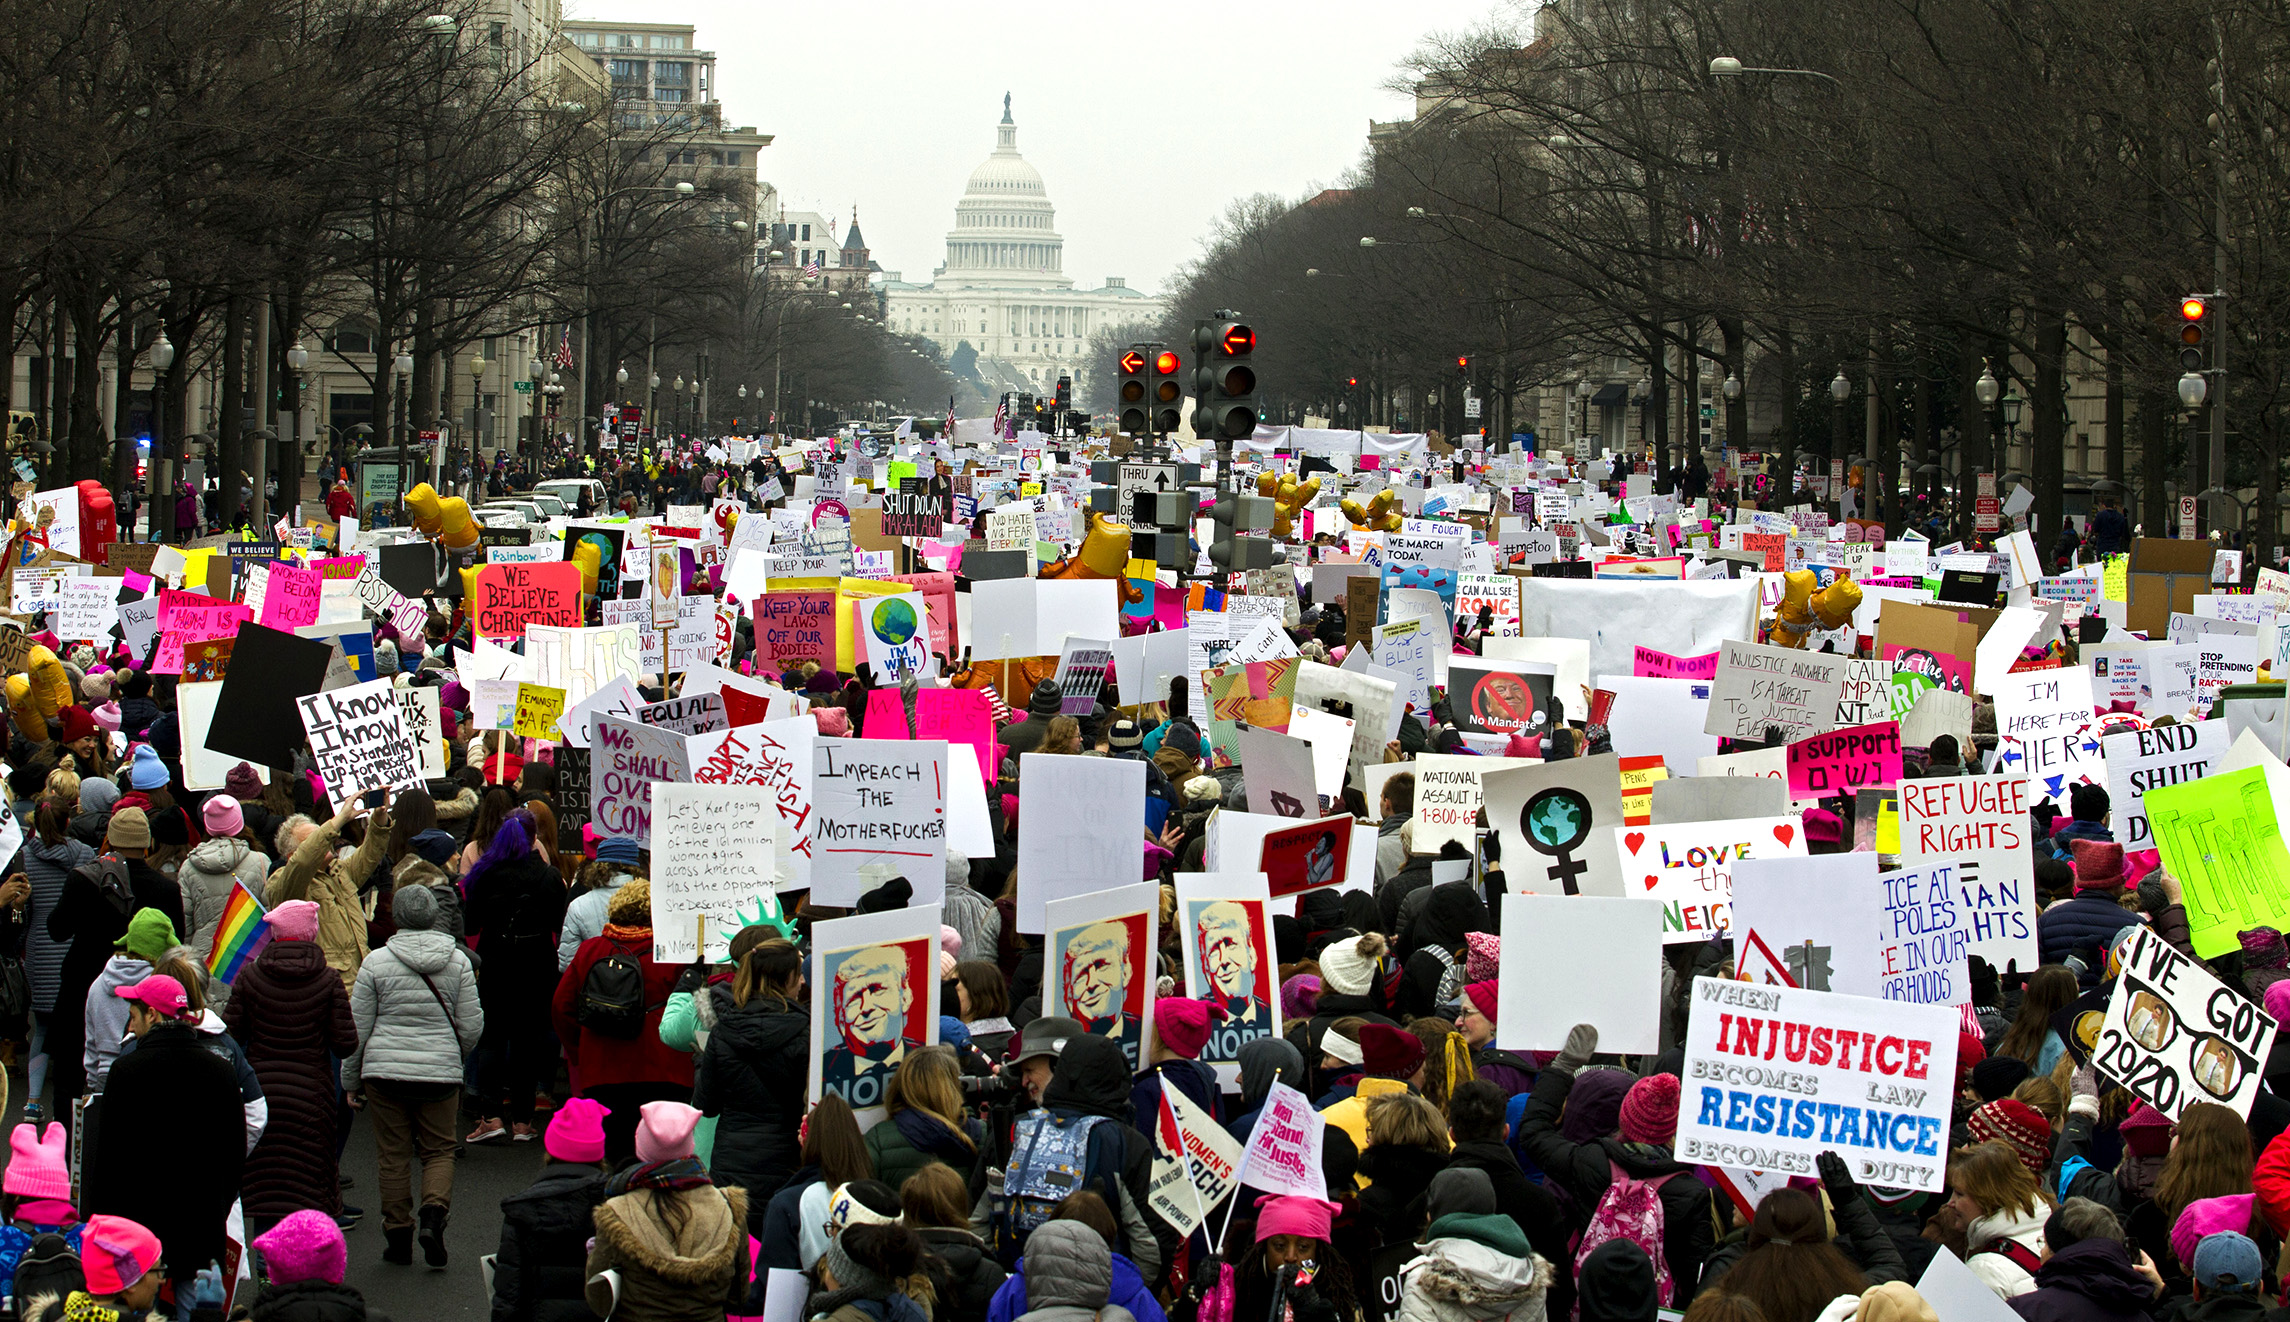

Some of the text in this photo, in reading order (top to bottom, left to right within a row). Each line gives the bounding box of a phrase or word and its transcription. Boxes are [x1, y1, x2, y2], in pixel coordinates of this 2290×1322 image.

[819, 463, 838, 473] THIS
[1123, 468, 1149, 480] THRU
[818, 472, 839, 480] AIN'T
[883, 494, 942, 516] SHUT DOWN
[993, 514, 1031, 525] NO HATE
[1121, 518, 1154, 530] SIGNAL
[991, 527, 1032, 538] NO FEAR
[1408, 522, 1464, 535] WE FOUGHT
[482, 536, 522, 546] THE POWER
[991, 538, 1030, 549] EVERYONE
[1388, 538, 1443, 550] WE MARCH
[1744, 534, 1756, 542] THIS
[1503, 540, 1551, 555] #metoo
[1754, 543, 1786, 551] MOMENT
[1845, 545, 1870, 554] SPEAK
[492, 551, 537, 562] Rainbow
[1388, 551, 1423, 561] TODAY.
[1768, 555, 1782, 564] THE
[1852, 555, 1863, 563] UP
[773, 557, 828, 571] KEEP YOUR
[272, 564, 315, 583] WOMEN
[503, 566, 530, 587] WE
[1463, 586, 1512, 596] CAN ALL SEE
[1876, 580, 1892, 588] YOU
[78, 592, 91, 601] only
[93, 592, 108, 601] thing
[1254, 596, 1278, 606] YOUR
[81, 601, 99, 609] afraid
[605, 601, 641, 612] UNLESS
[657, 603, 676, 612] IMPEACH
[763, 597, 830, 619] KEEP YOUR
[125, 609, 154, 626] REAL
[217, 611, 232, 629] IS
[605, 613, 620, 624] YOU
[783, 616, 818, 628] LAWS
[679, 632, 707, 644] GOING
[767, 629, 824, 645] OFF OUR
[768, 644, 822, 660] BODIES.
[890, 645, 909, 657] I'M
[1385, 647, 1423, 667] BLUE
[2200, 653, 2224, 661] STOP
[1636, 649, 1717, 672] NOW I WON'T
[1729, 648, 1788, 674] INJUSTICE
[2200, 661, 2254, 672] PRETENDING
[2199, 670, 2222, 679] YOUR
[519, 688, 558, 708] FEMINIST
[1766, 683, 1776, 698] A
[2027, 680, 2059, 702] I'M
[326, 689, 396, 723] know
[1867, 709, 1884, 719] but
[2008, 710, 2089, 733] HERE FOR
[1469, 713, 1537, 731] No Mandate
[336, 715, 400, 747] know
[2137, 724, 2198, 757] END
[2023, 735, 2081, 773] HER
[817, 746, 921, 781] IMPEACH
[348, 762, 374, 781] for
[384, 764, 416, 786] SUCH
[1422, 770, 1478, 784] NATIONAL
[857, 788, 893, 806] THE
[1421, 788, 1471, 805] ASSAULT
[1903, 779, 2027, 822] REFUGEE
[734, 801, 760, 817] going
[692, 820, 754, 838] every one
[818, 818, 946, 841] MOTHERFUCKER
[668, 838, 681, 849] of
[685, 838, 709, 848] the
[716, 838, 730, 847] 161
[1920, 822, 2020, 854] RIGHTS
[670, 852, 708, 862] women
[1659, 841, 1756, 869] LOVE
[665, 864, 758, 877] across America
[667, 880, 718, 892] Has the
[665, 899, 684, 912] She
[1894, 900, 1956, 939] POLES
[1698, 981, 1781, 1013] WHEN
[2207, 986, 2277, 1056] GOT
[1716, 1012, 1933, 1080] INJUSTICE
[2098, 1028, 2181, 1113] 20/20
[1690, 1057, 1927, 1108] BECOMES LAW
[1697, 1086, 1942, 1156] RESISTANCE
[1181, 1128, 1233, 1180] WOMEN'S
[1683, 1137, 1935, 1187] BECOMES DUTY
[1167, 1201, 1193, 1229] POWER
